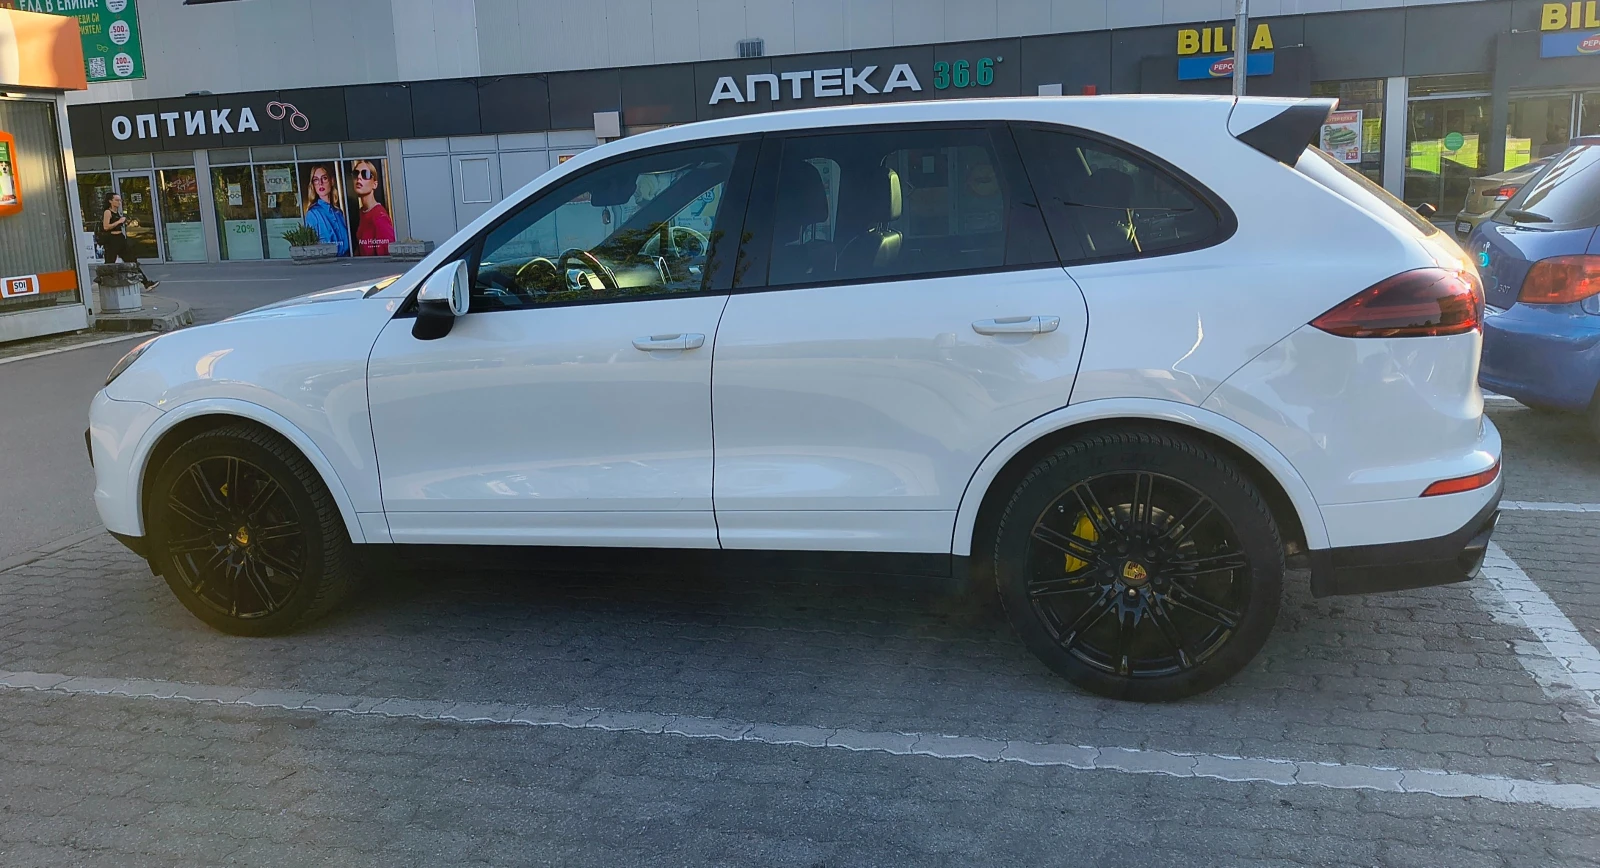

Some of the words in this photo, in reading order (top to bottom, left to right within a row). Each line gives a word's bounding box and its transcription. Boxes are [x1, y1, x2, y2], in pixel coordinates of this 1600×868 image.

[1583, 39, 1600, 47] PEP
[708, 63, 922, 105] АПТЕКА
[111, 106, 260, 141] ОПТИКА
[233, 224, 255, 234] -20%
[14, 281, 26, 290] SDI
